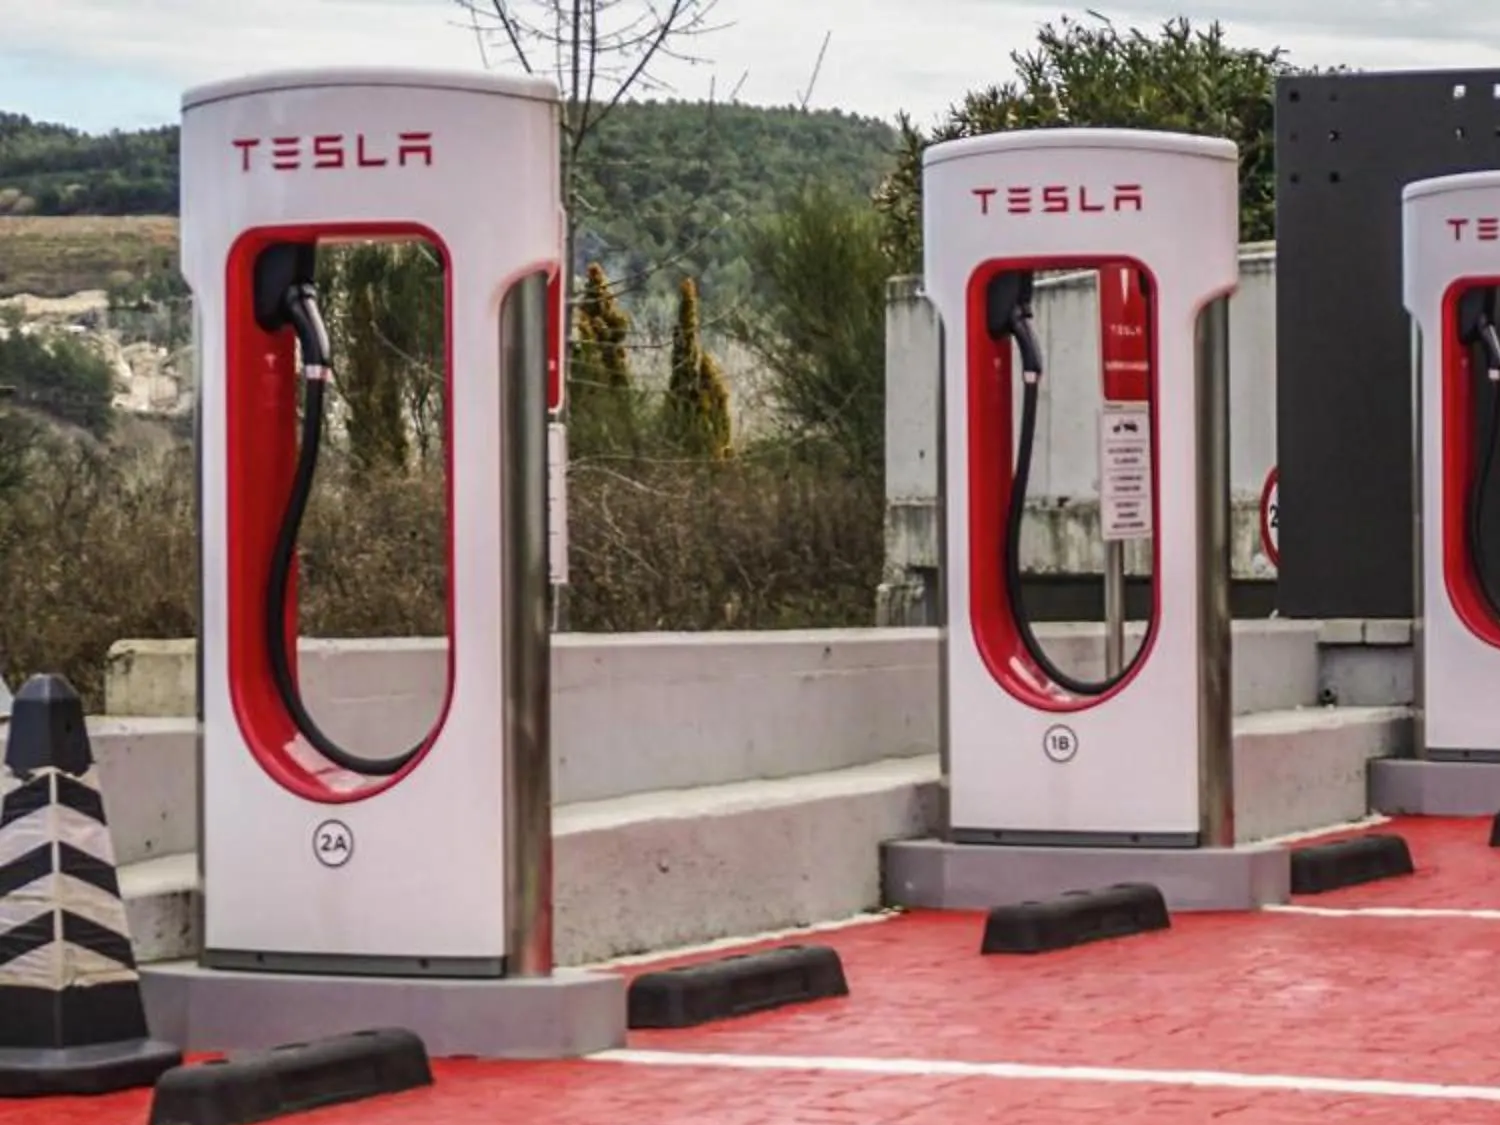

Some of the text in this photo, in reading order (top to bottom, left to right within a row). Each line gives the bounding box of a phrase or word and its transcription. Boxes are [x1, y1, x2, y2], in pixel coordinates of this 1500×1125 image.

[232, 132, 433, 172] TESLA
[972, 184, 1142, 214] TESLA
[1051, 735, 1070, 750] 1B
[321, 834, 348, 851] 2A
